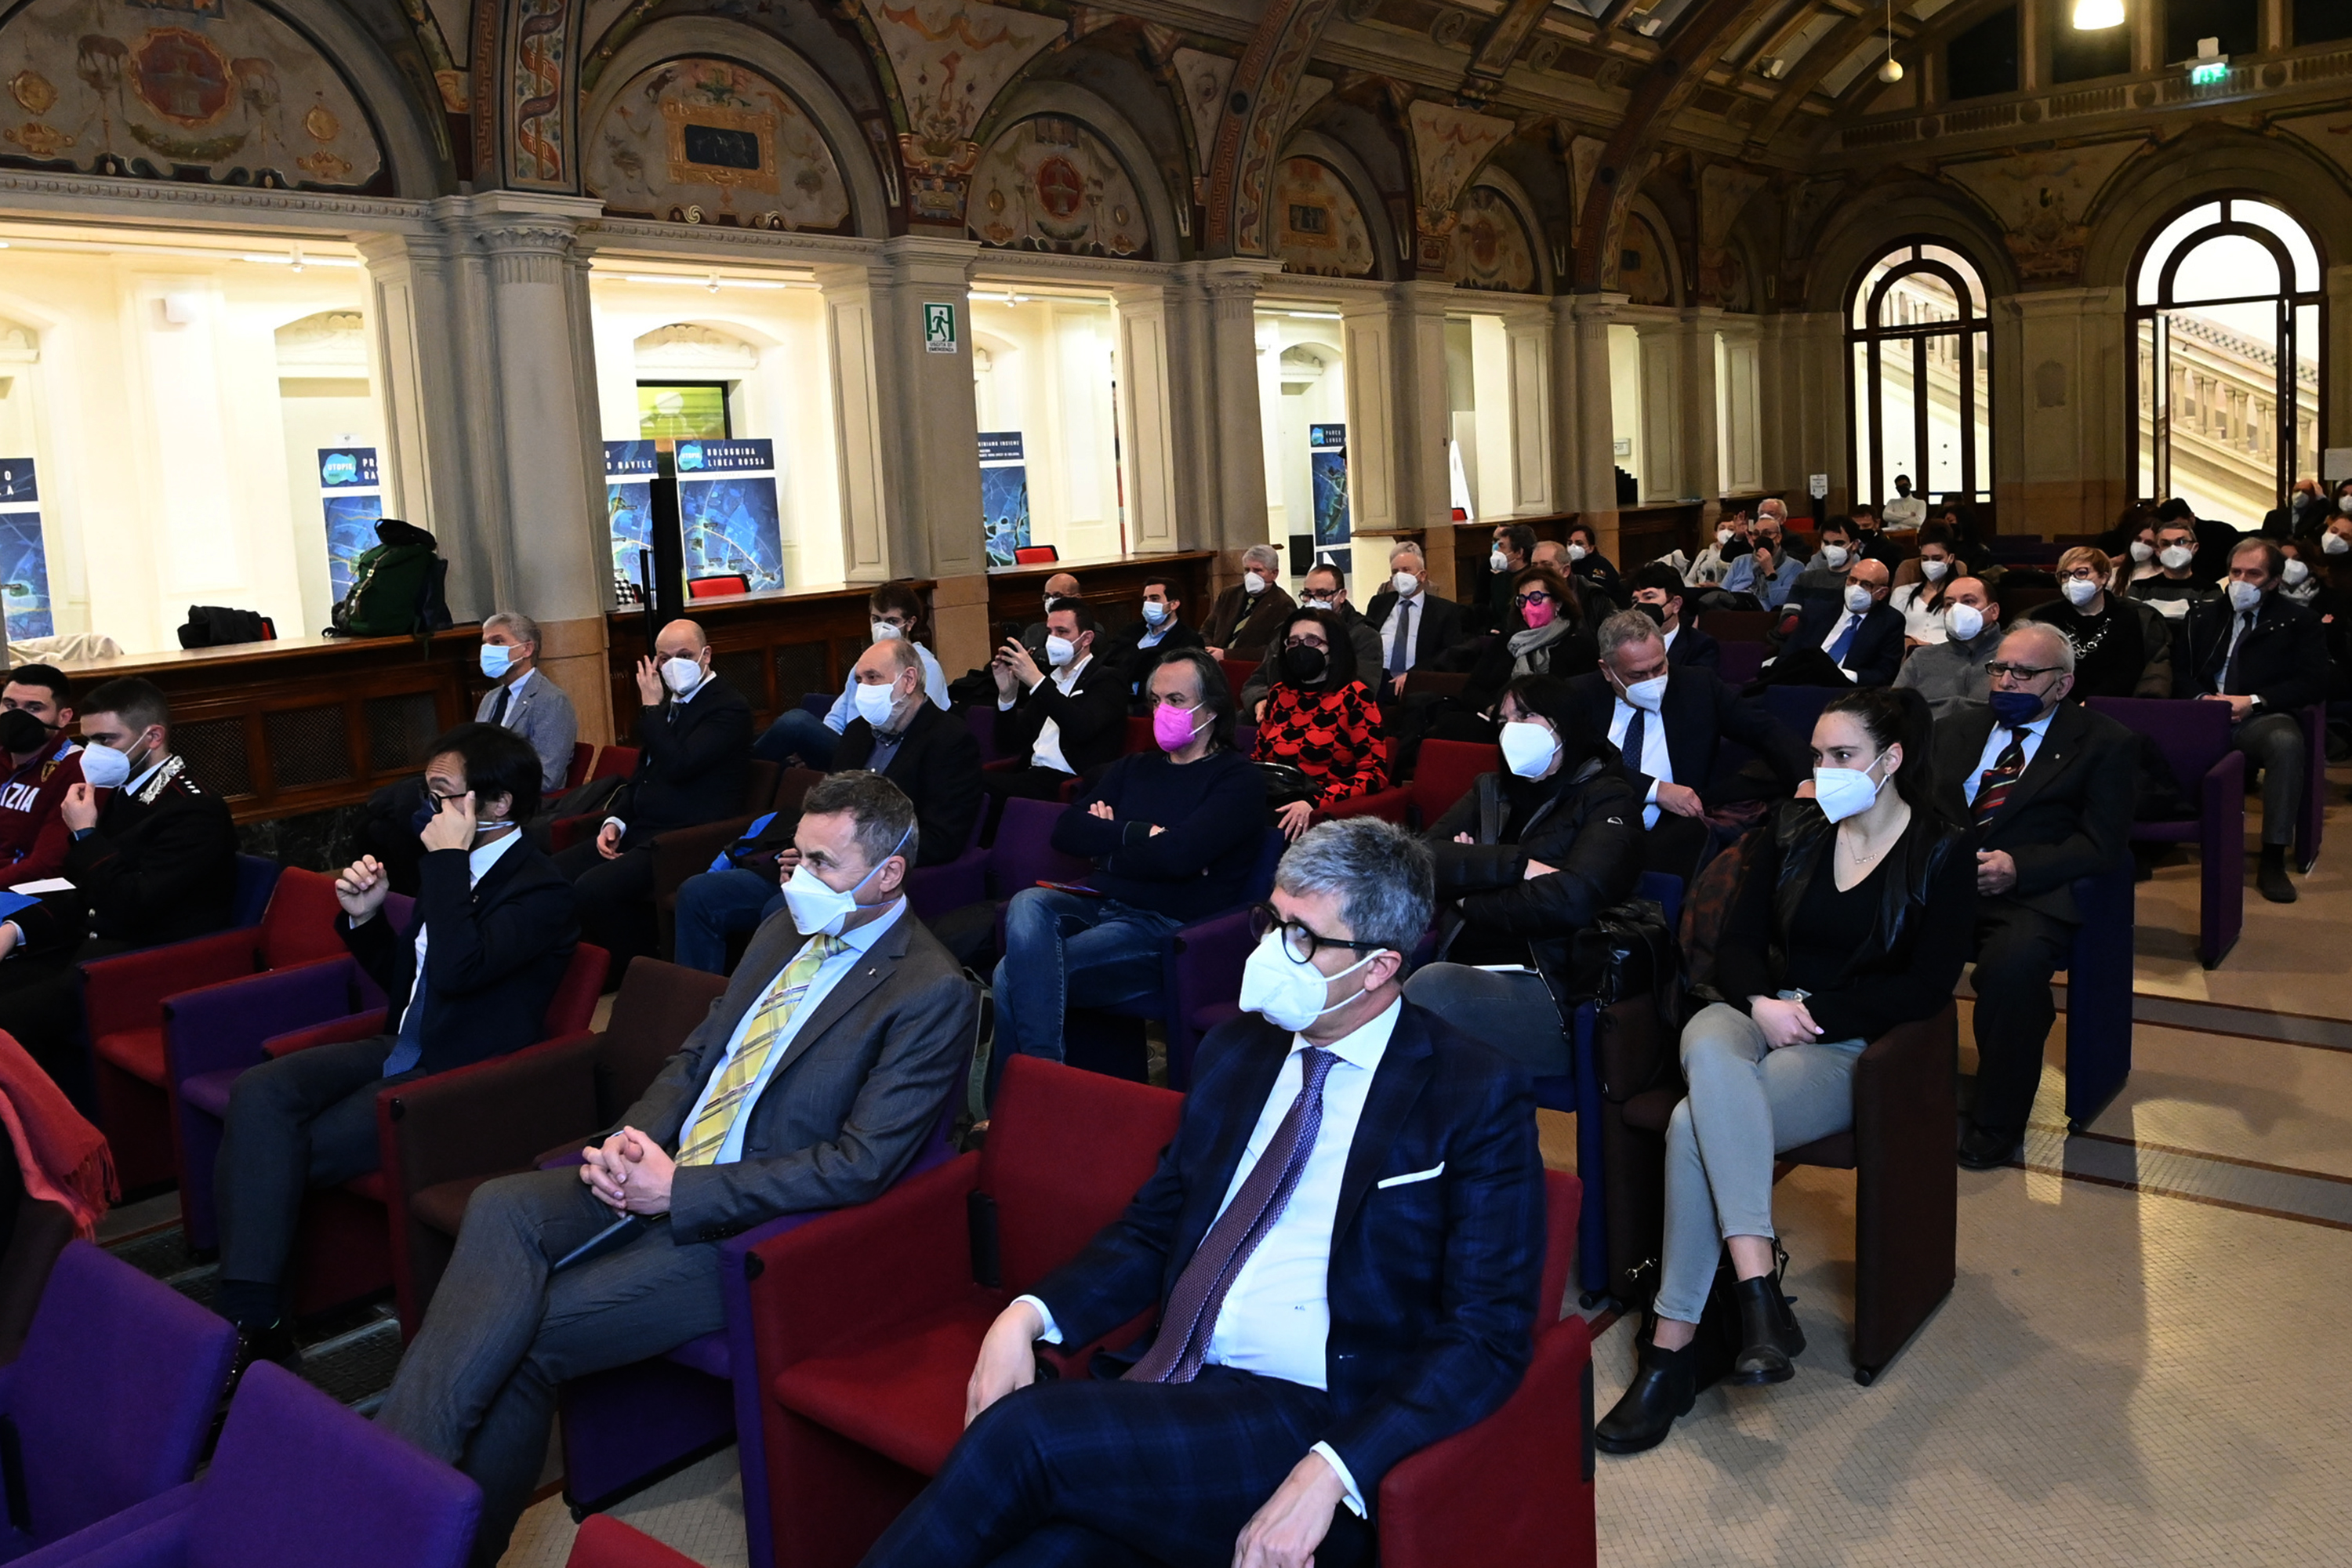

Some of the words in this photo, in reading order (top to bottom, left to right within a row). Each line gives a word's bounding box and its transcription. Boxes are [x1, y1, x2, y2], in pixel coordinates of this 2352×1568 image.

[707, 448, 756, 456] BOLOGNINA
[618, 459, 652, 470] NAVILE
[708, 459, 734, 467] LINEA
[739, 457, 765, 466] ROSSA
